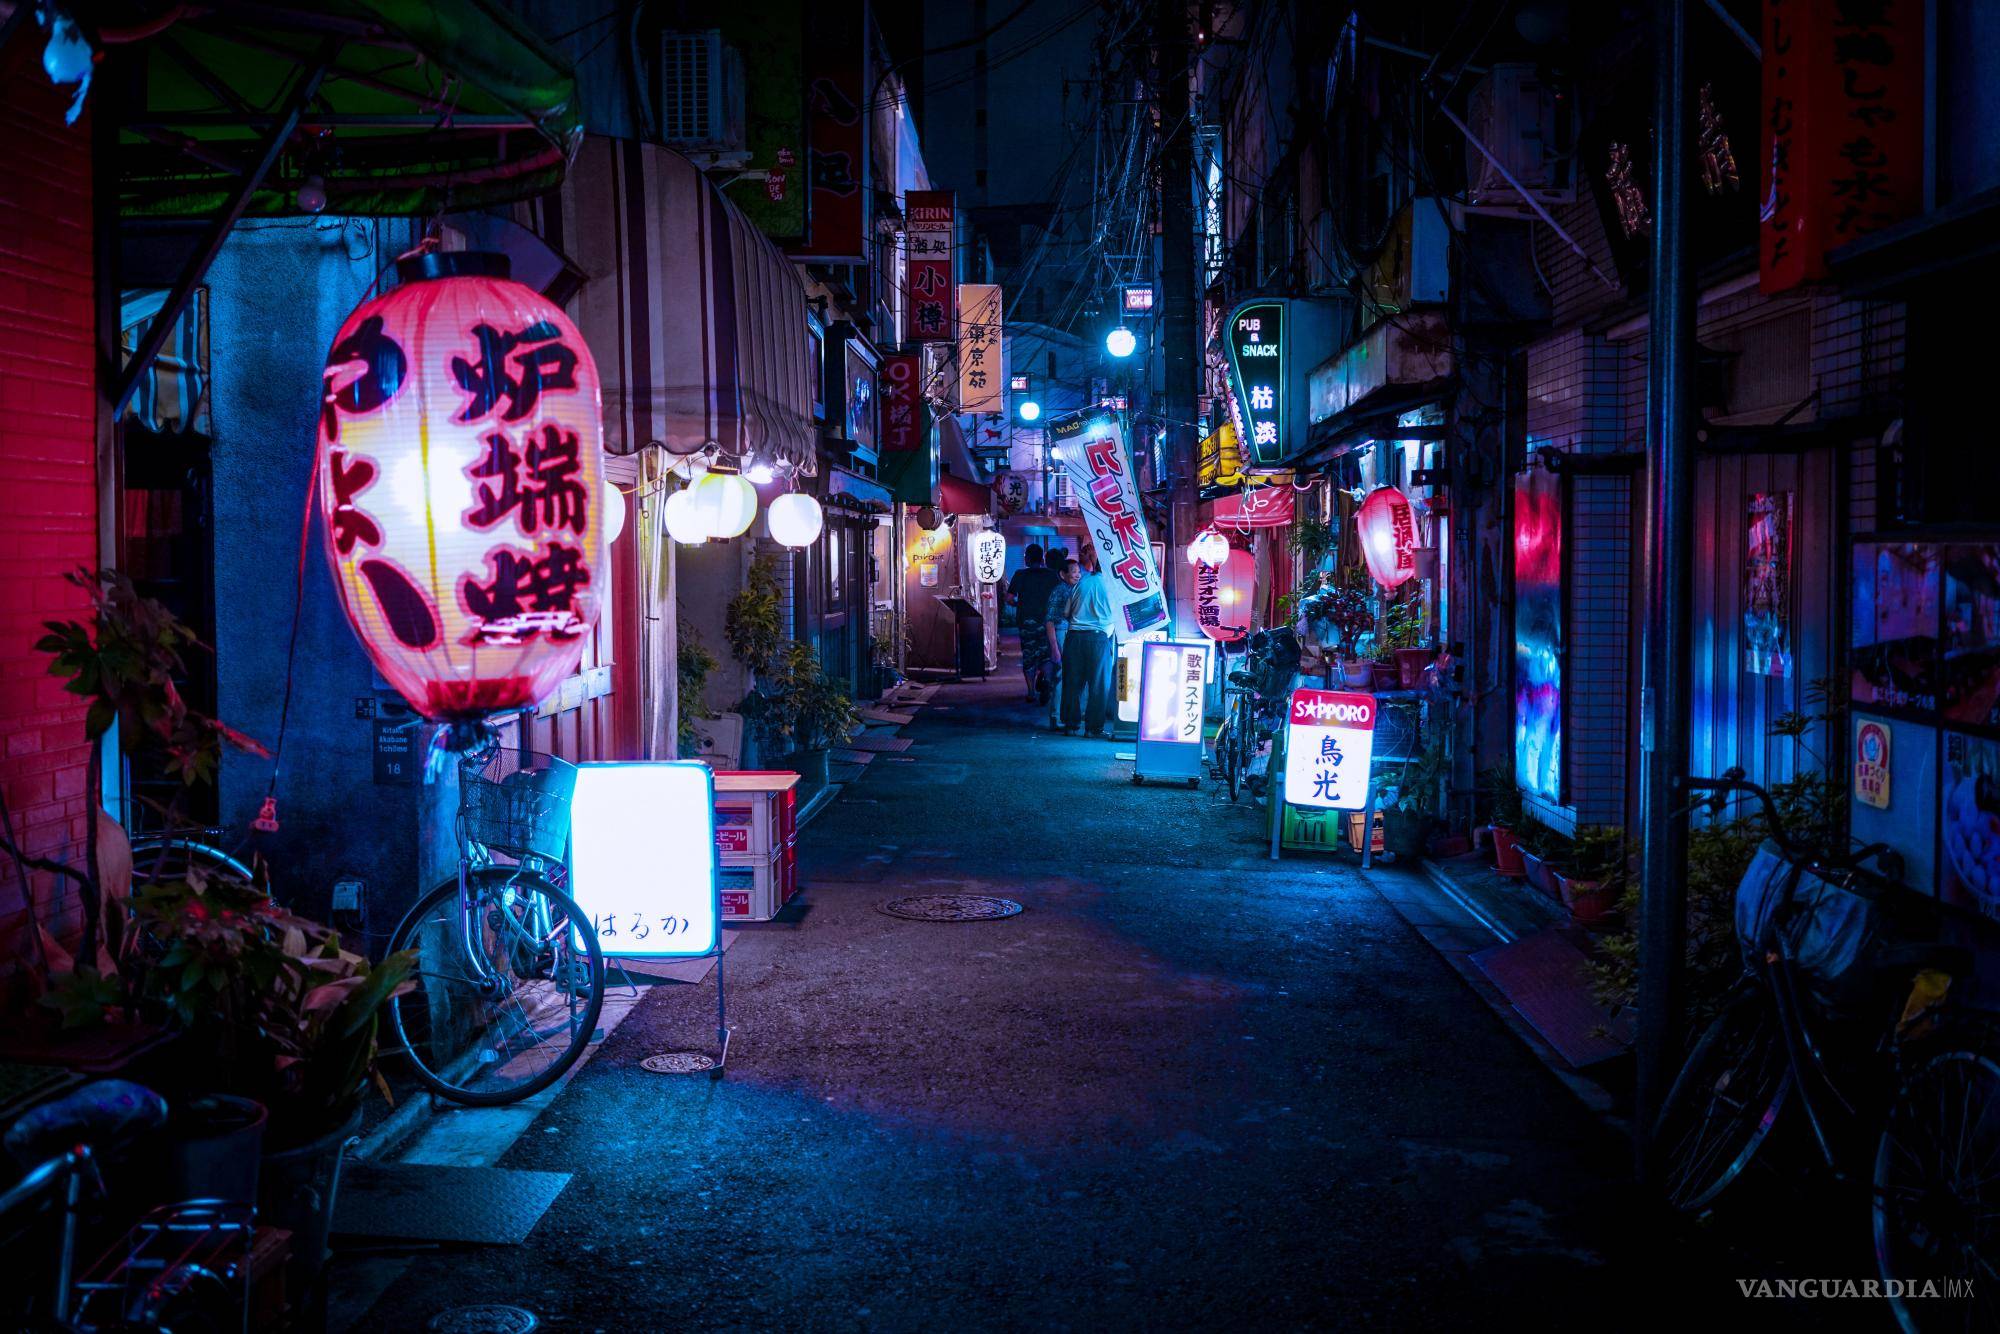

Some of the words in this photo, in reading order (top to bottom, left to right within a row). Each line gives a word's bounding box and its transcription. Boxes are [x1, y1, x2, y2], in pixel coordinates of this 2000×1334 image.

[914, 264, 946, 334] 小樽
[1239, 319, 1260, 331] PUB
[969, 324, 987, 389] 東京苑
[1243, 344, 1278, 357] SNACK
[1251, 385, 1277, 444] 枯淡
[1184, 653, 1202, 736] 歌声スナック
[379, 735, 408, 743] Akabane
[386, 763, 400, 775] 18
[1312, 734, 1343, 801] 鳥光
[594, 913, 689, 940] はるか
